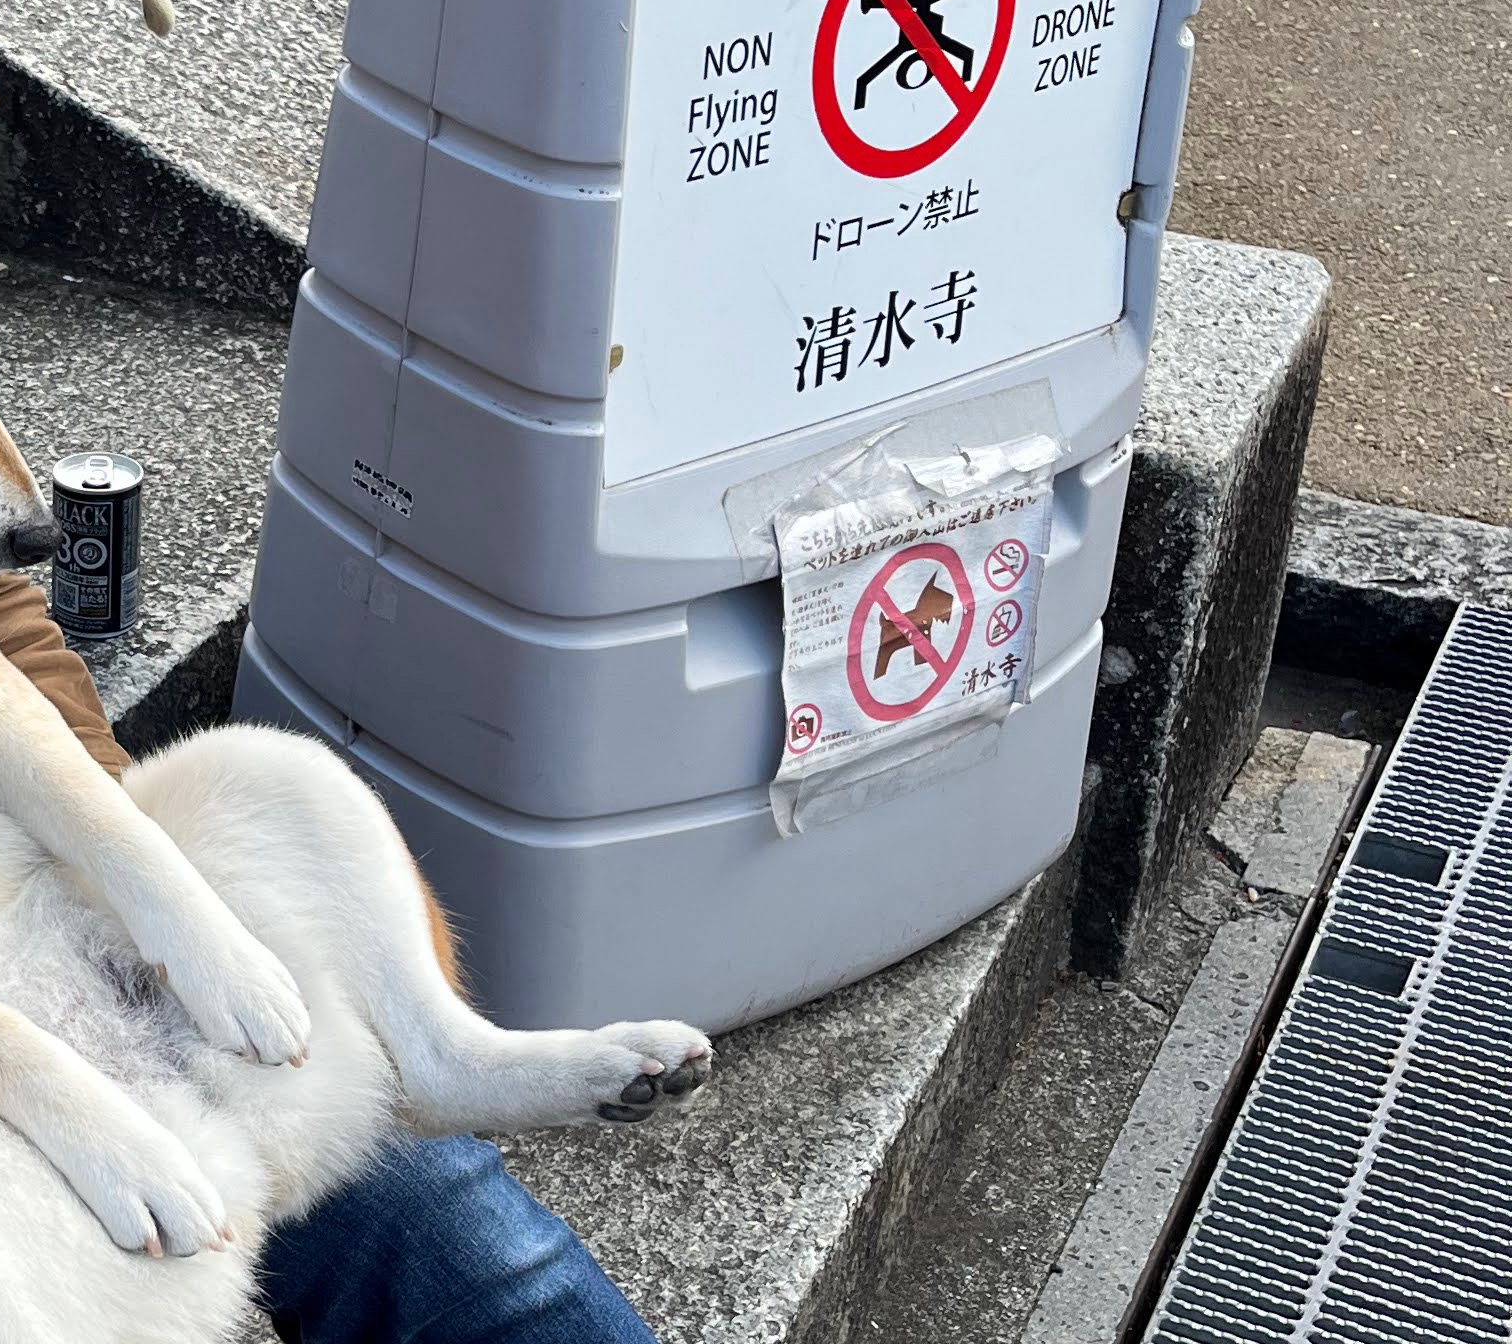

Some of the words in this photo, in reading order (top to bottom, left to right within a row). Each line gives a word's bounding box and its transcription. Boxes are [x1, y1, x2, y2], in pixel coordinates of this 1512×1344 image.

[703, 31, 773, 81] NON
[1034, 43, 1102, 93] ZONE
[688, 89, 779, 138] Flying
[687, 131, 771, 183] ZONE
[811, 178, 980, 261] ドローン禁止
[794, 269, 978, 394] 清水寺
[56, 495, 109, 526] BLACK
[961, 652, 1022, 697] 清水寺
